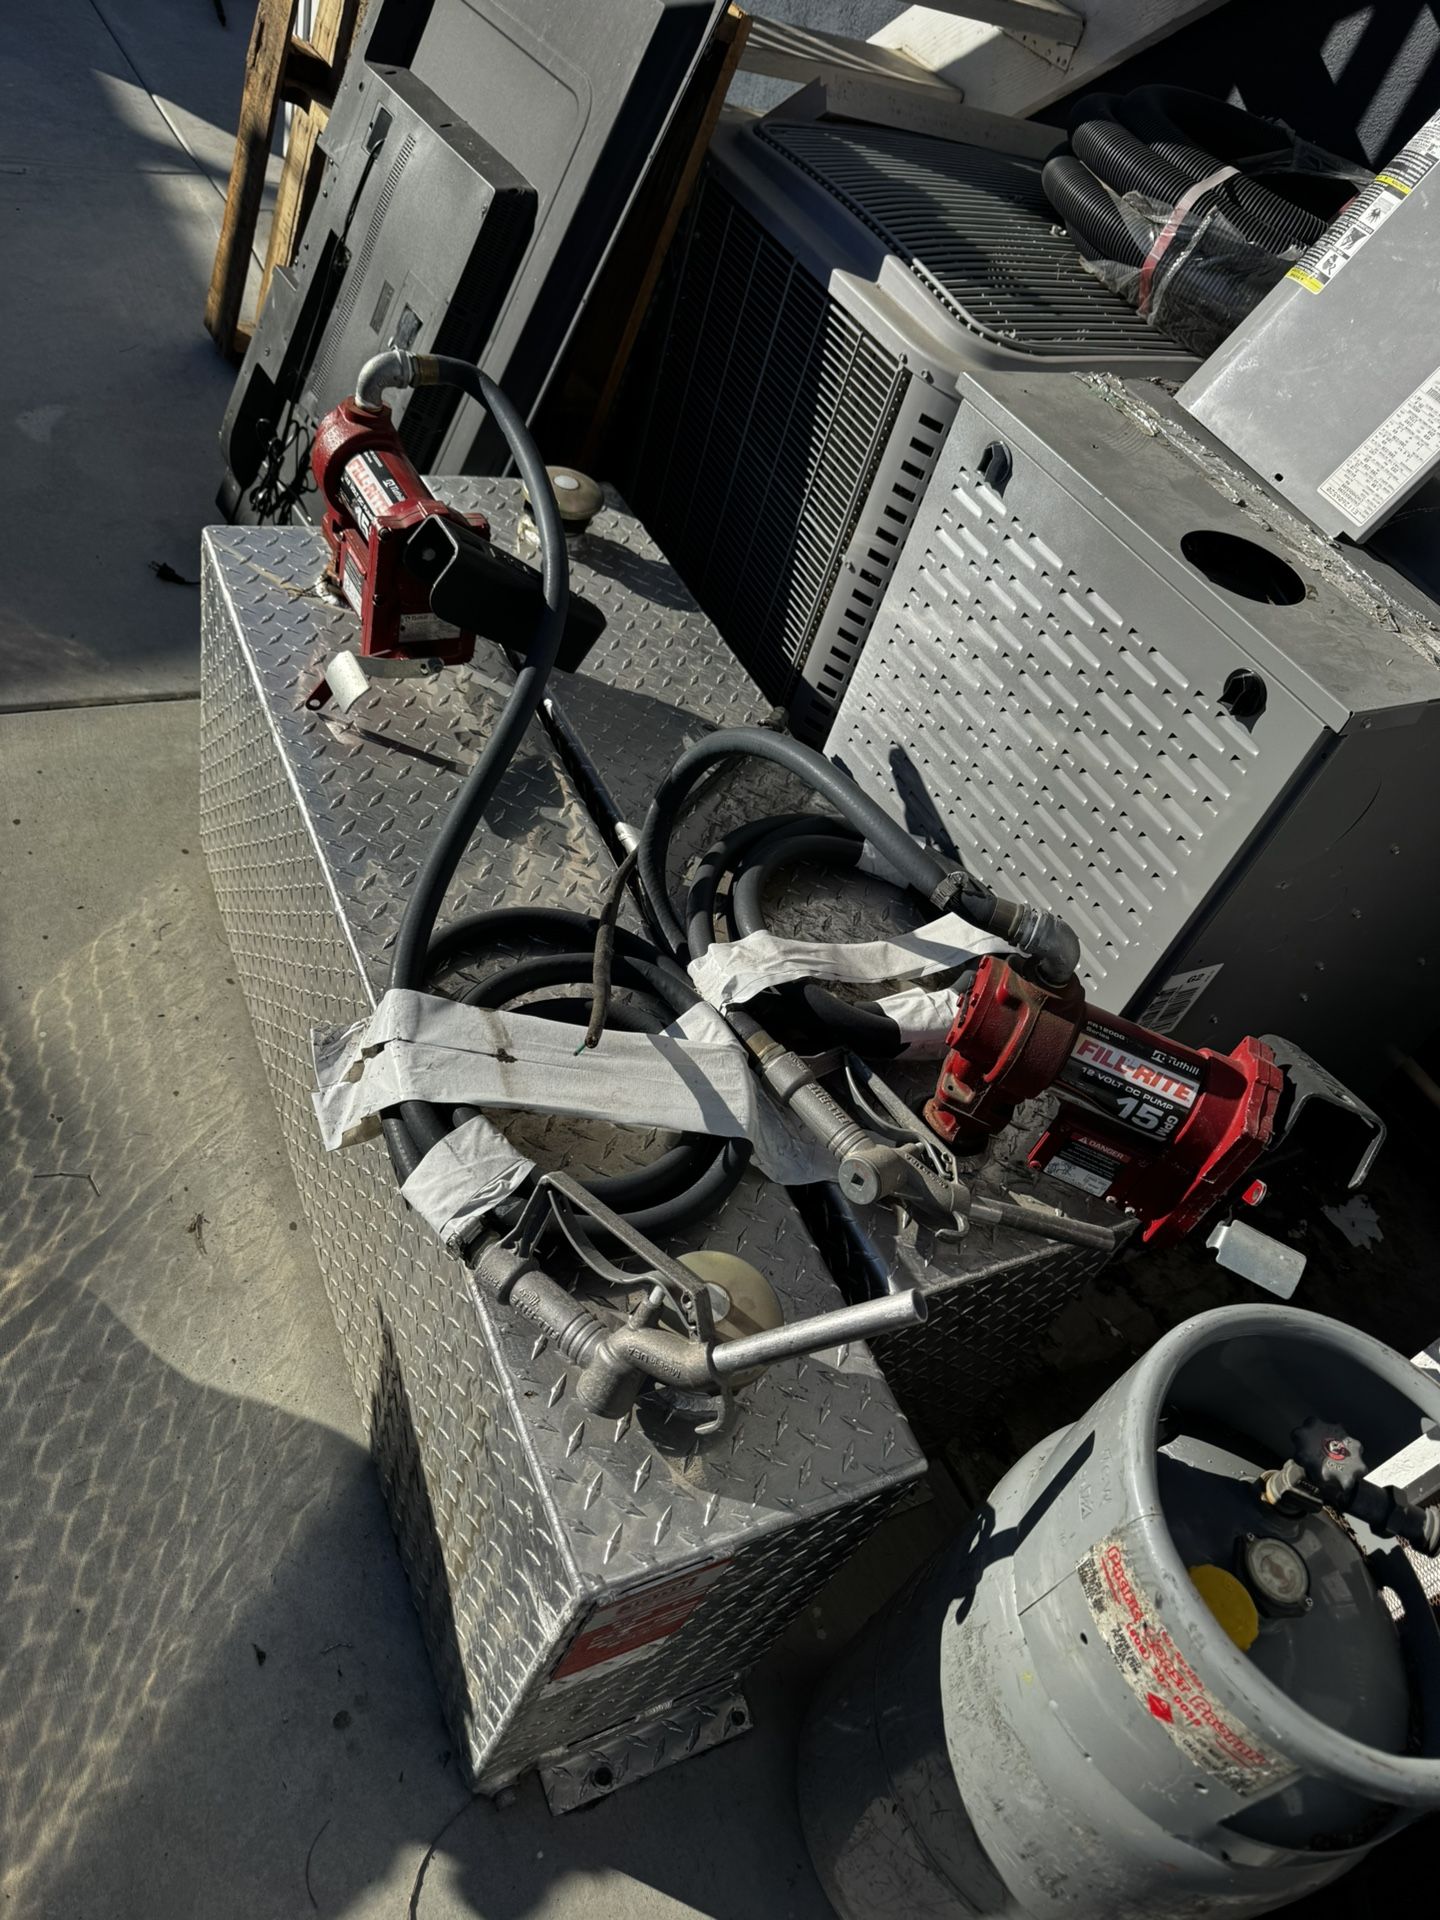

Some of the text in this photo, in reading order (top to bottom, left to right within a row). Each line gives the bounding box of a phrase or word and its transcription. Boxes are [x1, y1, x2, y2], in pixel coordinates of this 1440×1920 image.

[1076, 1041, 1195, 1102] FILL-RITE
[1167, 1056, 1200, 1076] Tuthill
[1095, 1072, 1123, 1088] VOLT
[1124, 1085, 1141, 1097] DC
[1142, 1093, 1174, 1111] PUMP
[1115, 1096, 1164, 1130] 15
[1154, 1115, 1179, 1137] GPM
[1087, 1139, 1125, 1160] DANGER
[627, 1345, 650, 1364] USA
